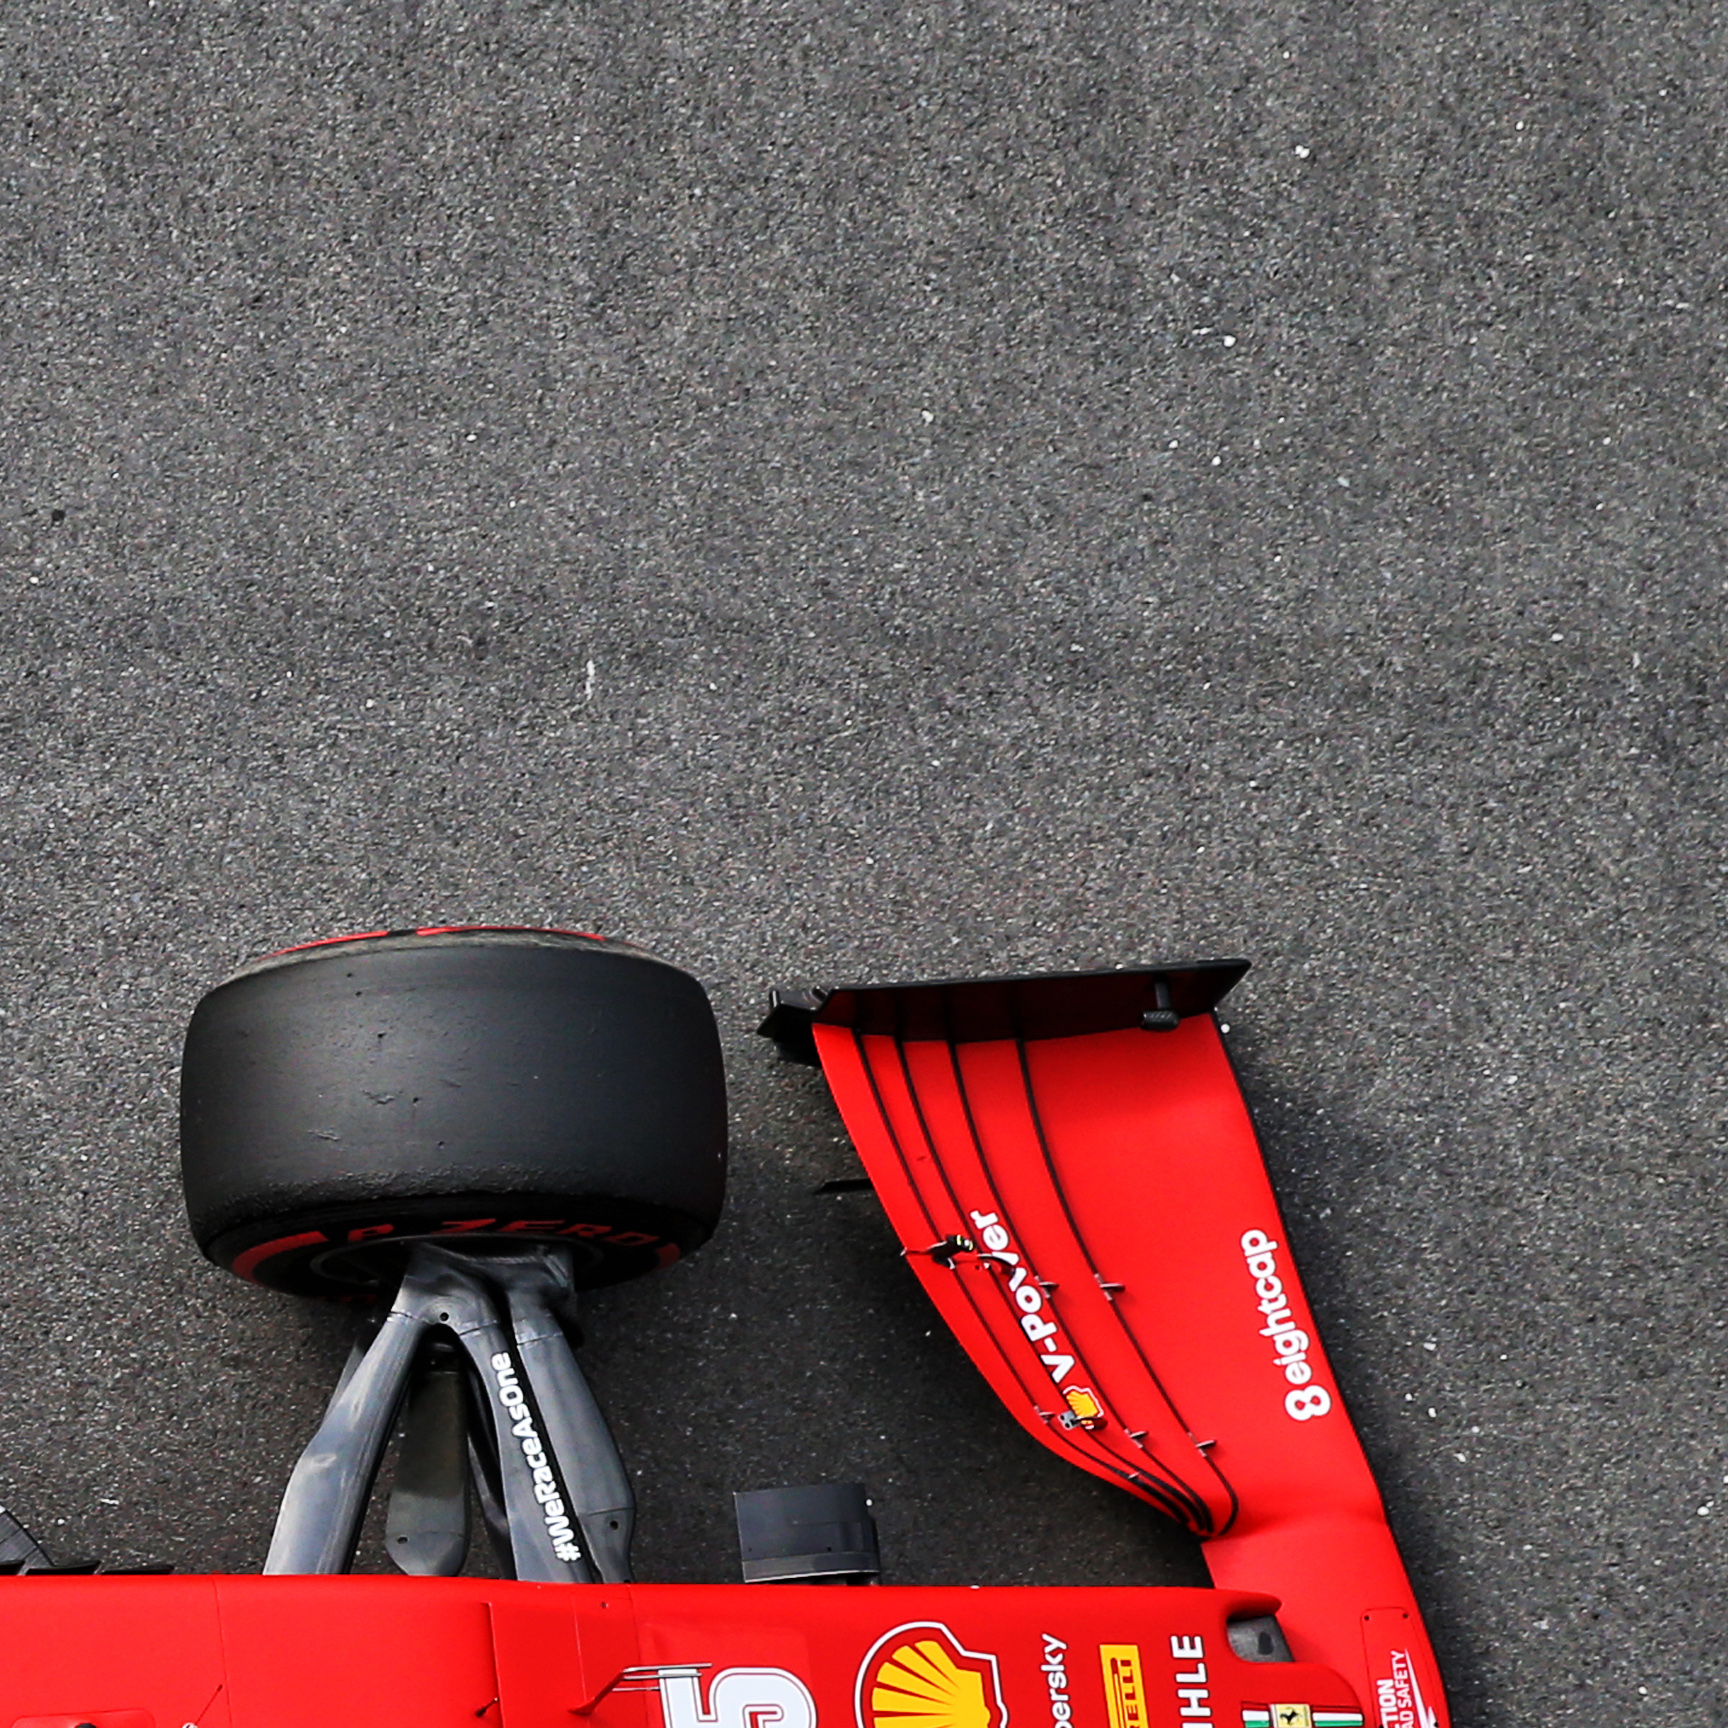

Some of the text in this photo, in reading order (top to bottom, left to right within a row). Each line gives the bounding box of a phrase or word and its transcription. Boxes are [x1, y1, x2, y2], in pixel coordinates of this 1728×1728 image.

[970, 1210, 1076, 1384] V-Power
[1240, 1229, 1313, 1385] eightcap
[491, 1351, 582, 1562] #WeRaceAsOne
[1390, 1650, 1414, 1709] SAFETY
